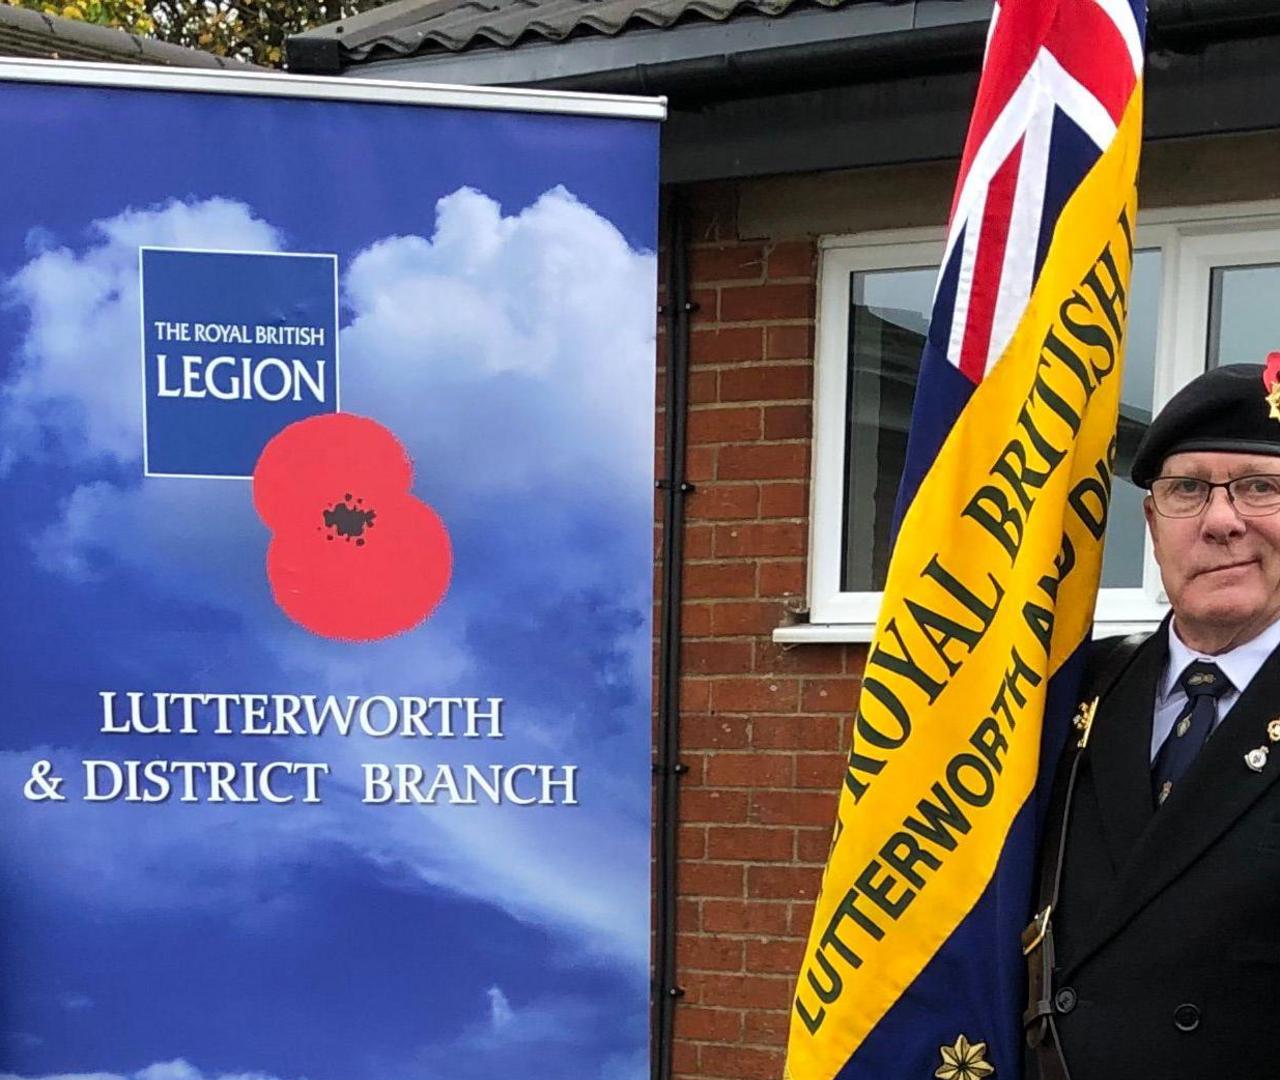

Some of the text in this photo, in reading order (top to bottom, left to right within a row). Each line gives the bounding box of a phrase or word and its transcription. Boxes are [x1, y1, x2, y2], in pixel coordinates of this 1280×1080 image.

[154, 321, 325, 346] THE ROYAL BRITISH
[156, 354, 326, 403] LEGION
[961, 240, 1128, 567] BRITISH
[98, 690, 505, 738] LUTTERWORTH
[23, 758, 579, 805] & DISTRICT BRANCH
[795, 646, 1042, 1036] LUTTERWORTH
